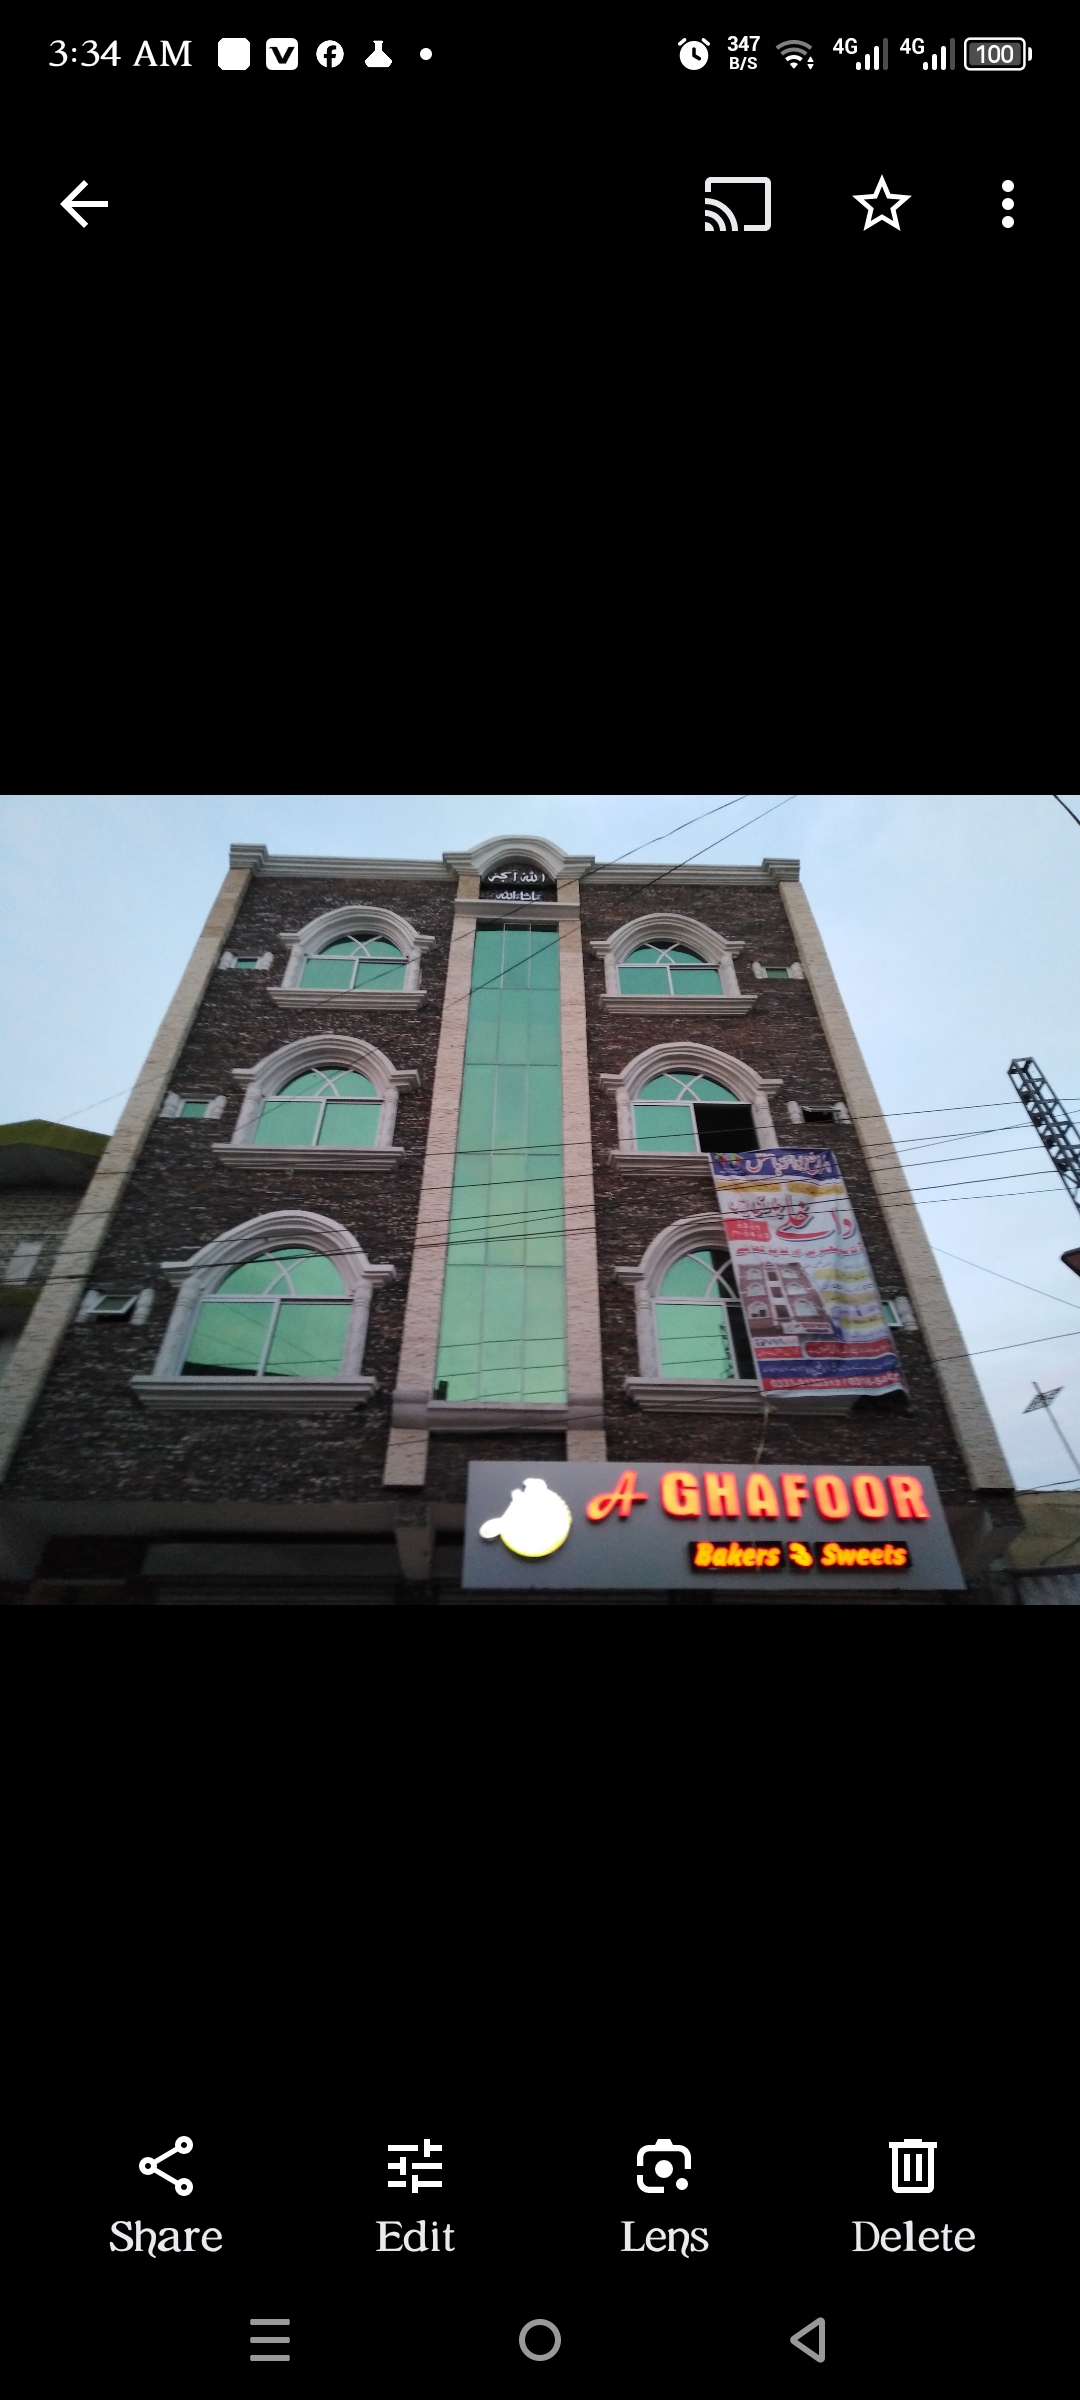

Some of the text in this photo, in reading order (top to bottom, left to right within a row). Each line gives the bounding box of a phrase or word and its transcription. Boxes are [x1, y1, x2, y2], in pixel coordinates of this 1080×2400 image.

[585, 1470, 932, 1521] A GHAFOOR
[693, 1541, 782, 1568] Bakers
[819, 1541, 908, 1567] Sweets
